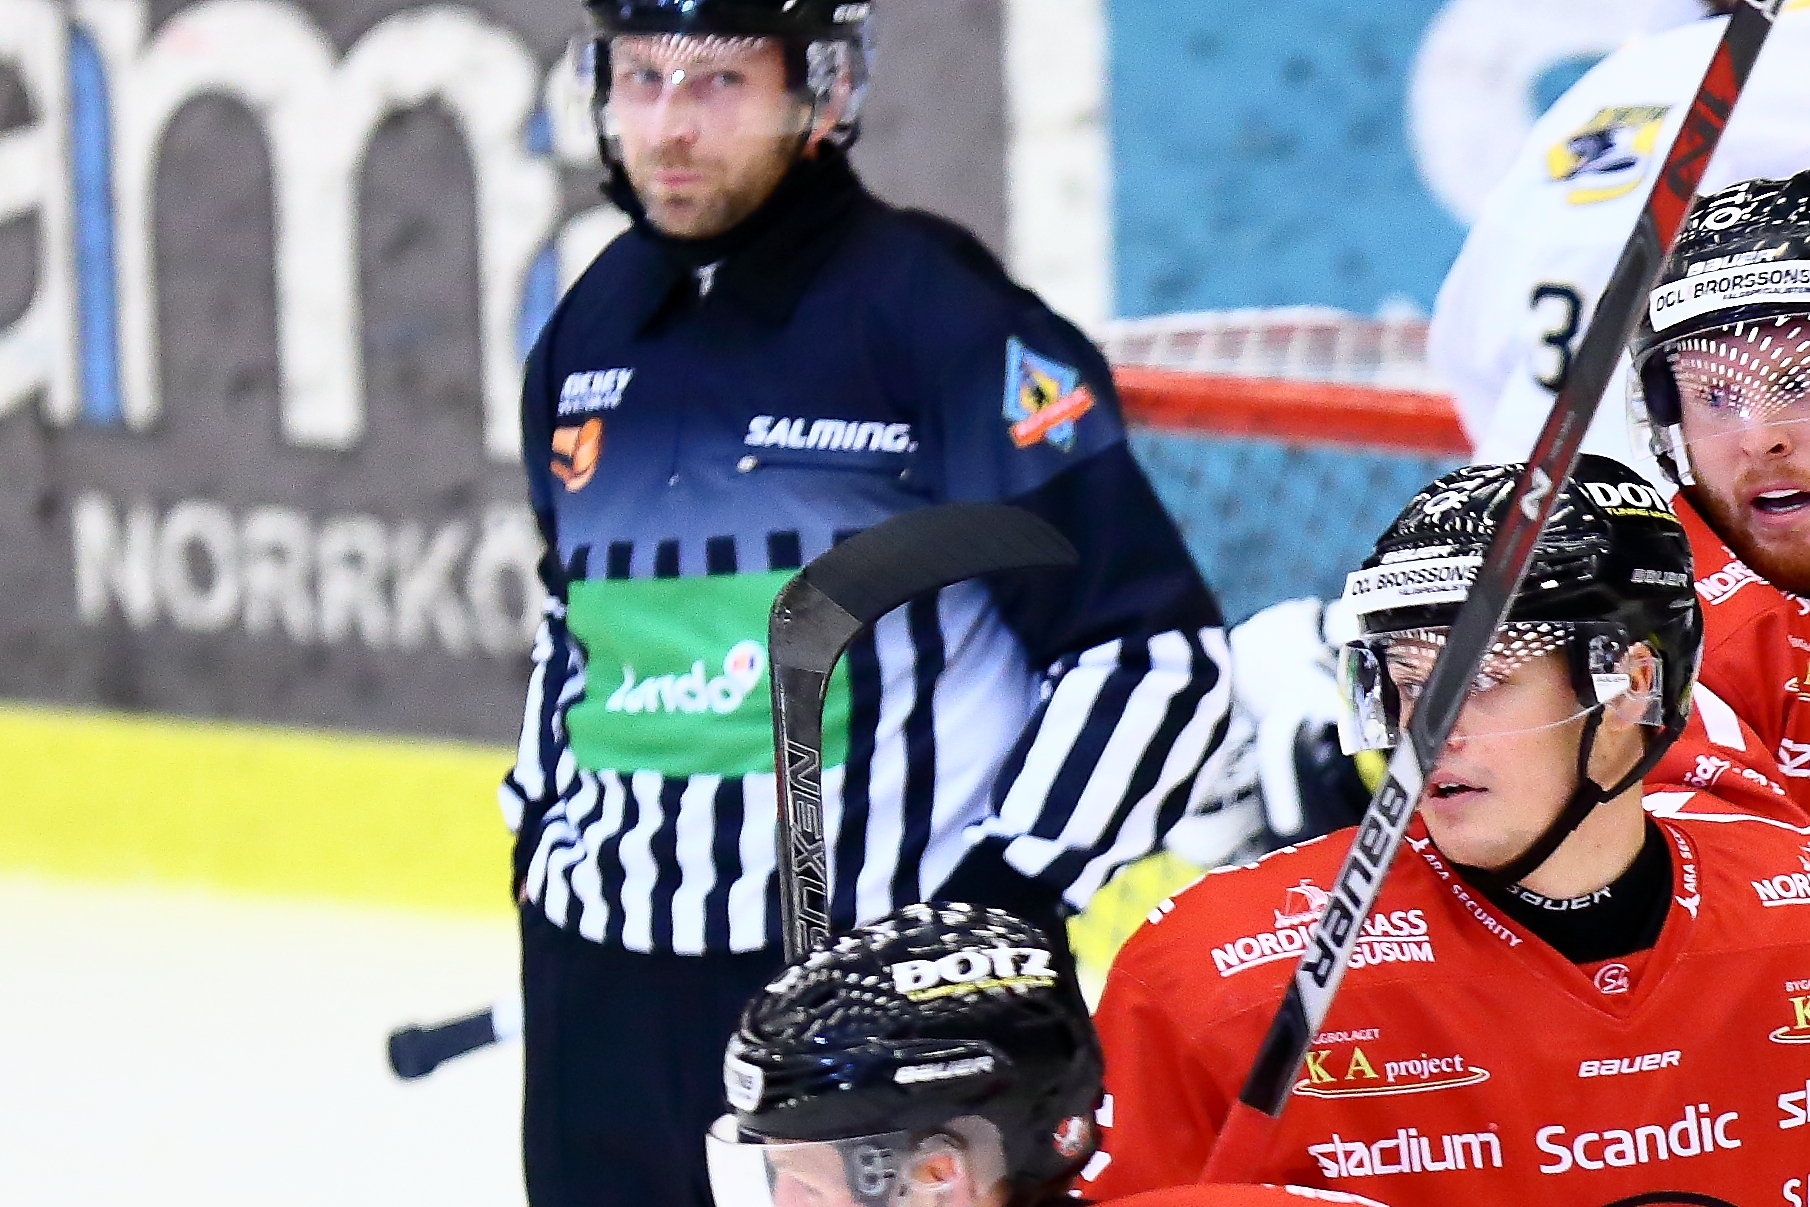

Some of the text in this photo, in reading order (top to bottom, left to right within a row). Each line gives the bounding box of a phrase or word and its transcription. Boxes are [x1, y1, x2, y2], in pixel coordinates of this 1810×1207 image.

[1422, 853, 1524, 948] ARA SECURITY
[1305, 1046, 1465, 1084] K A project
[1578, 1049, 1682, 1079] BAUER
[1307, 1126, 1503, 1179] stadium
[1535, 1103, 1742, 1175] Scandic
